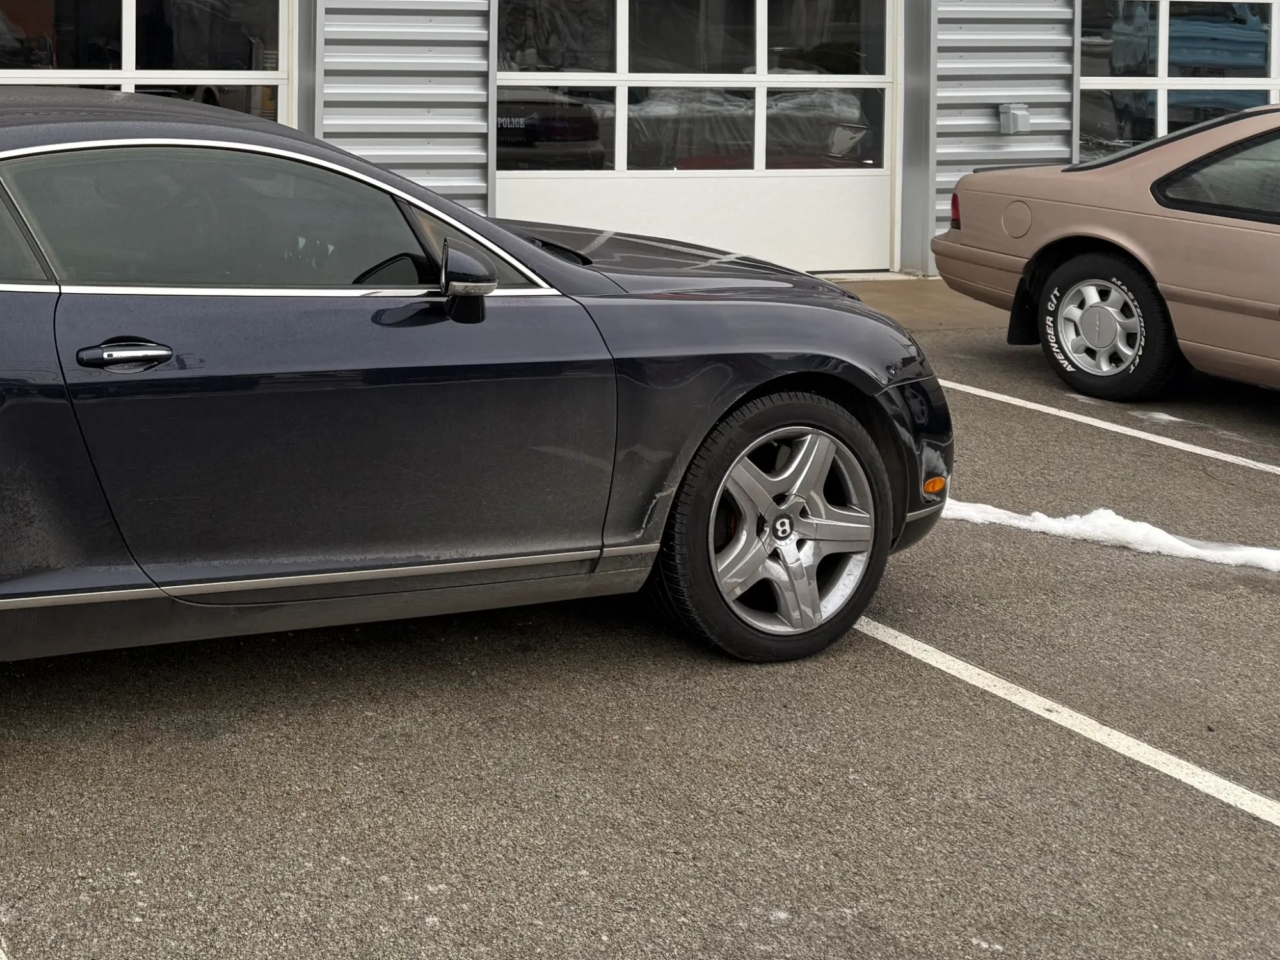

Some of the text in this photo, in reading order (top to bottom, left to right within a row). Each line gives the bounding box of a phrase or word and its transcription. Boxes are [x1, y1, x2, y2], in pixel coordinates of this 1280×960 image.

[498, 117, 525, 128] POLICE
[1045, 286, 1077, 372] AVENGER G/T
[1112, 277, 1146, 374] MASTERCRAFT
